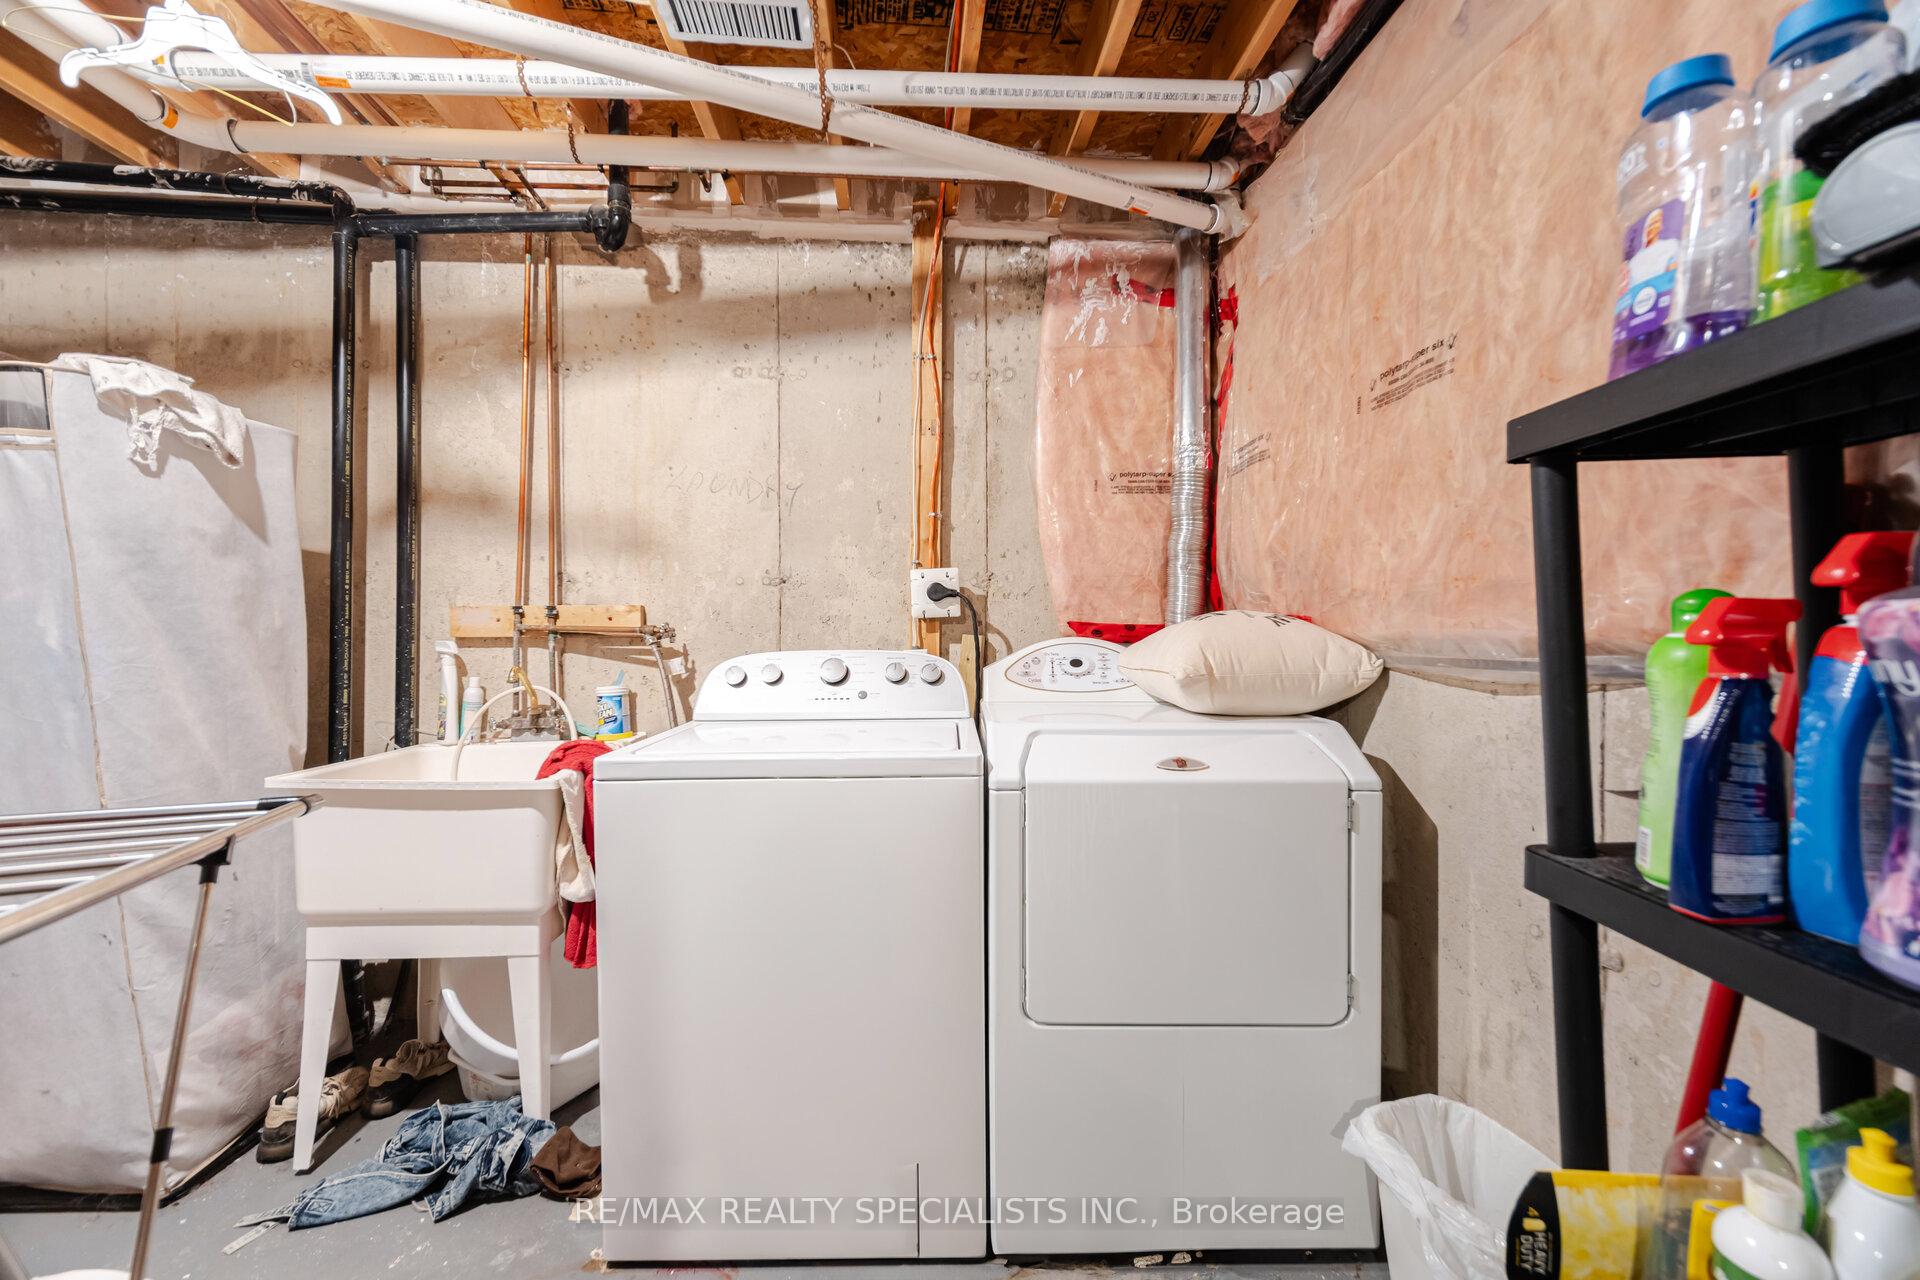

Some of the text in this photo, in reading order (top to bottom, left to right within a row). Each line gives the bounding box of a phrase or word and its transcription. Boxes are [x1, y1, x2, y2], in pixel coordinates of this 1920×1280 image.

[1432, 339, 1445, 351] six
[1520, 1234, 1534, 1272] DUTY
[1533, 1231, 1548, 1276] HEAVY
